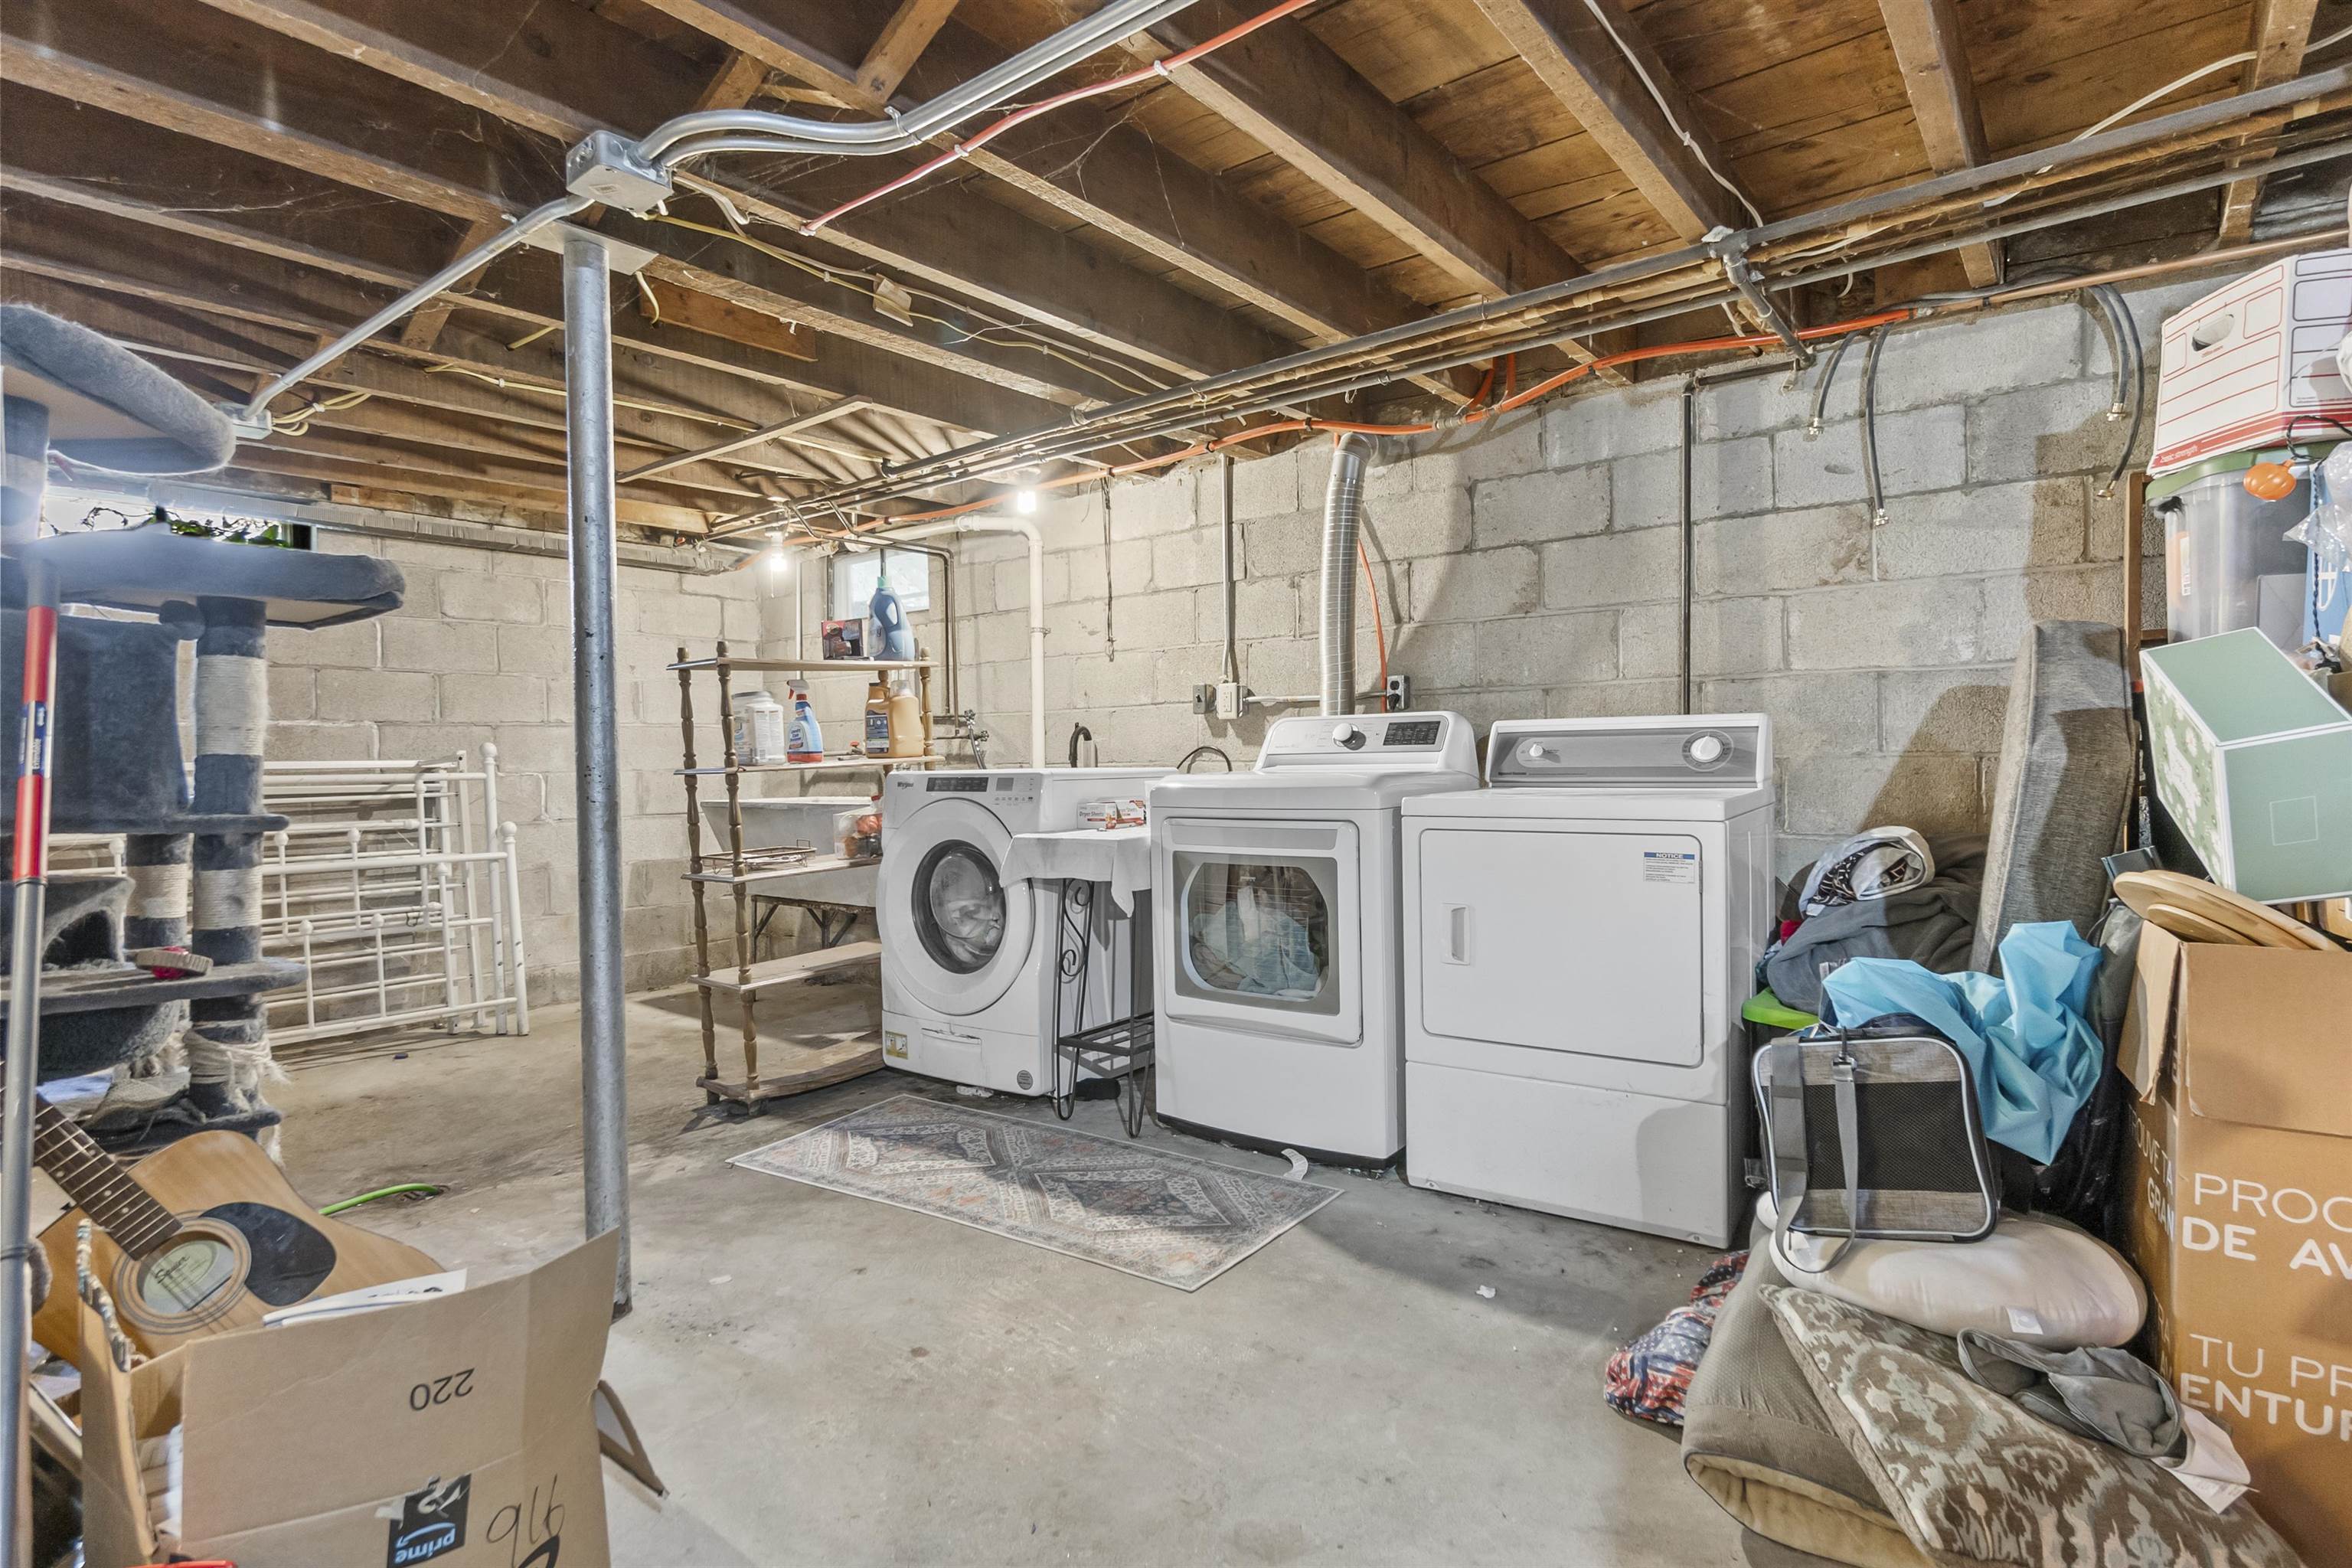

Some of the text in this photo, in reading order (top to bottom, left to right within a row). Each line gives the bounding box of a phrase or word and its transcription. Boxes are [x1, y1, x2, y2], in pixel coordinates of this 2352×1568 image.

[2147, 1177, 2257, 1262] GRAN DE
[2189, 1333, 2264, 1378] TU
[409, 1367, 475, 1411] 220
[394, 1527, 456, 1564] prime
